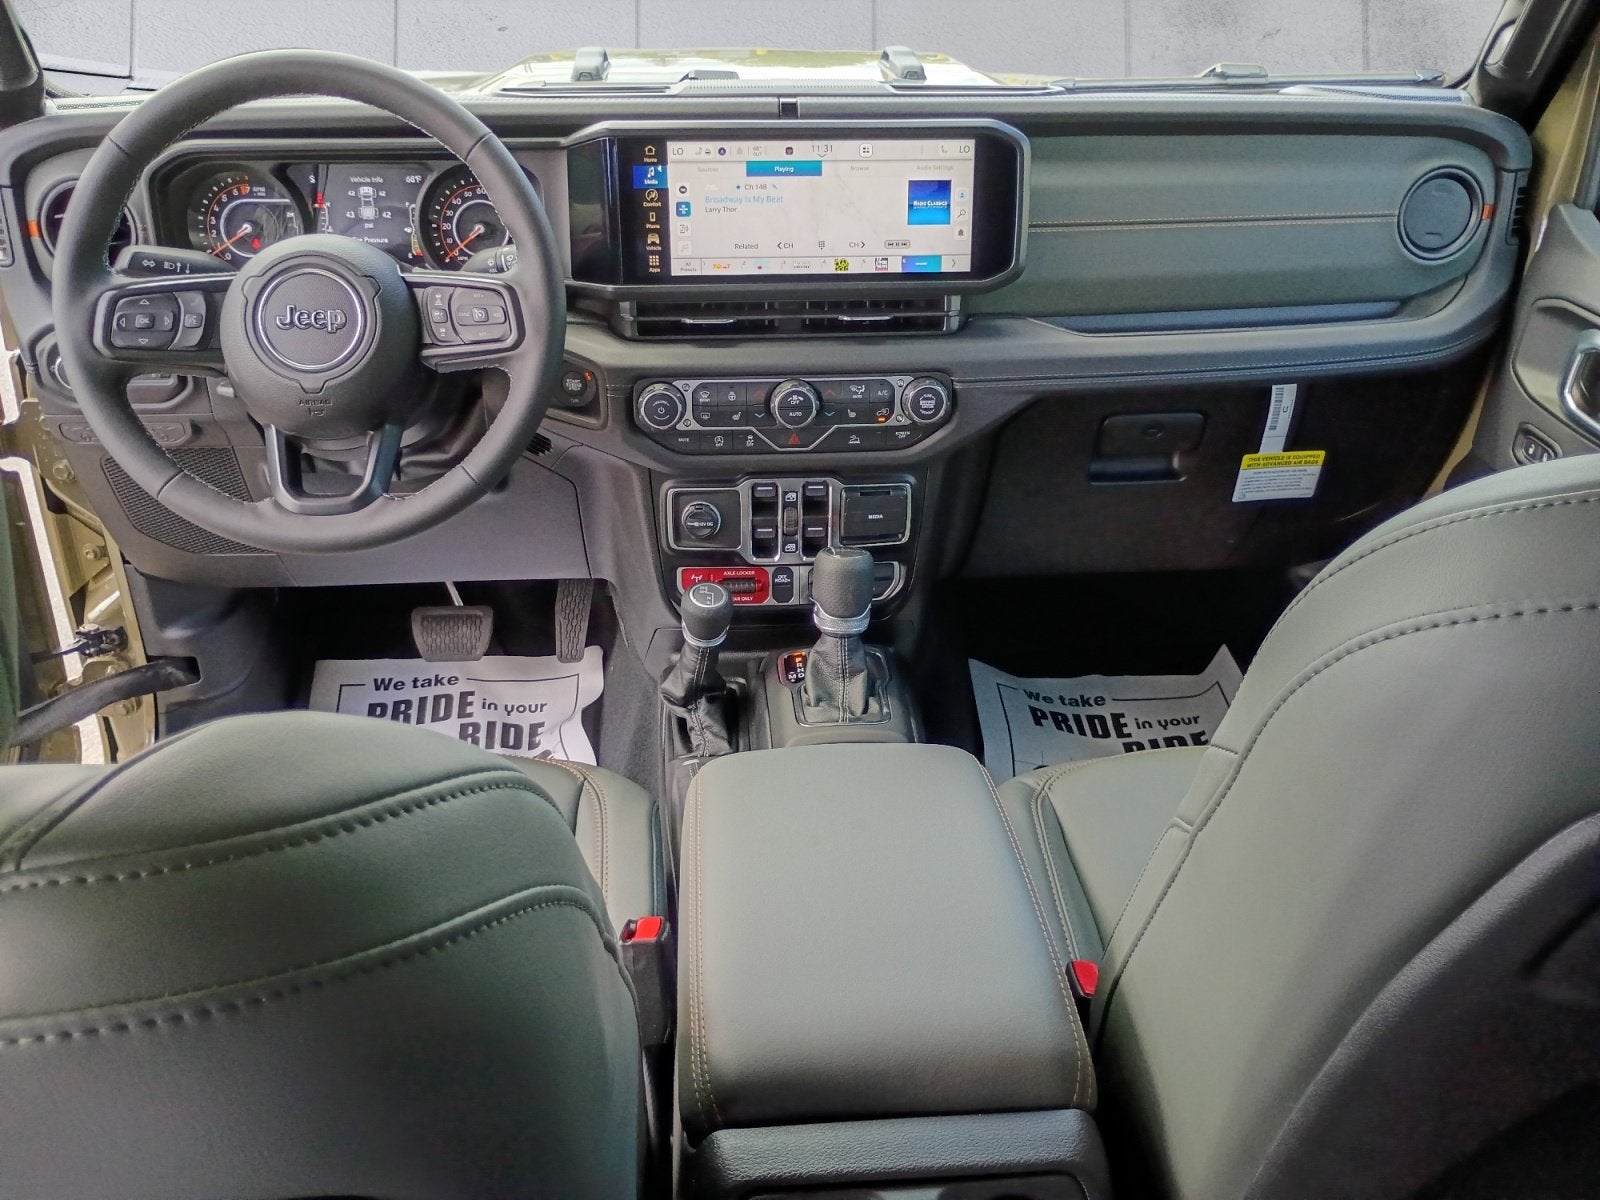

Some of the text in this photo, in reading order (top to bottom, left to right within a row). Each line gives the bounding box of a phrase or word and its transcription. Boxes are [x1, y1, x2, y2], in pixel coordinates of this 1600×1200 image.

[672, 148, 684, 156] LO
[811, 144, 834, 153] 11:31
[959, 146, 971, 154] LO
[774, 165, 794, 173] Playing
[704, 195, 743, 205] Broadway
[752, 195, 765, 205] My
[766, 195, 784, 204] Beat
[705, 206, 721, 214] Larry
[364, 222, 374, 230] psi
[442, 222, 452, 230] 20
[734, 242, 759, 250] Related
[849, 241, 860, 249] CH
[276, 304, 348, 334] Jeep
[373, 674, 459, 691] We take
[1023, 689, 1106, 708] We take
[367, 691, 548, 725] PRIDE in your
[1028, 705, 1200, 739] PRIDE in your
[459, 720, 546, 750] RIDE
